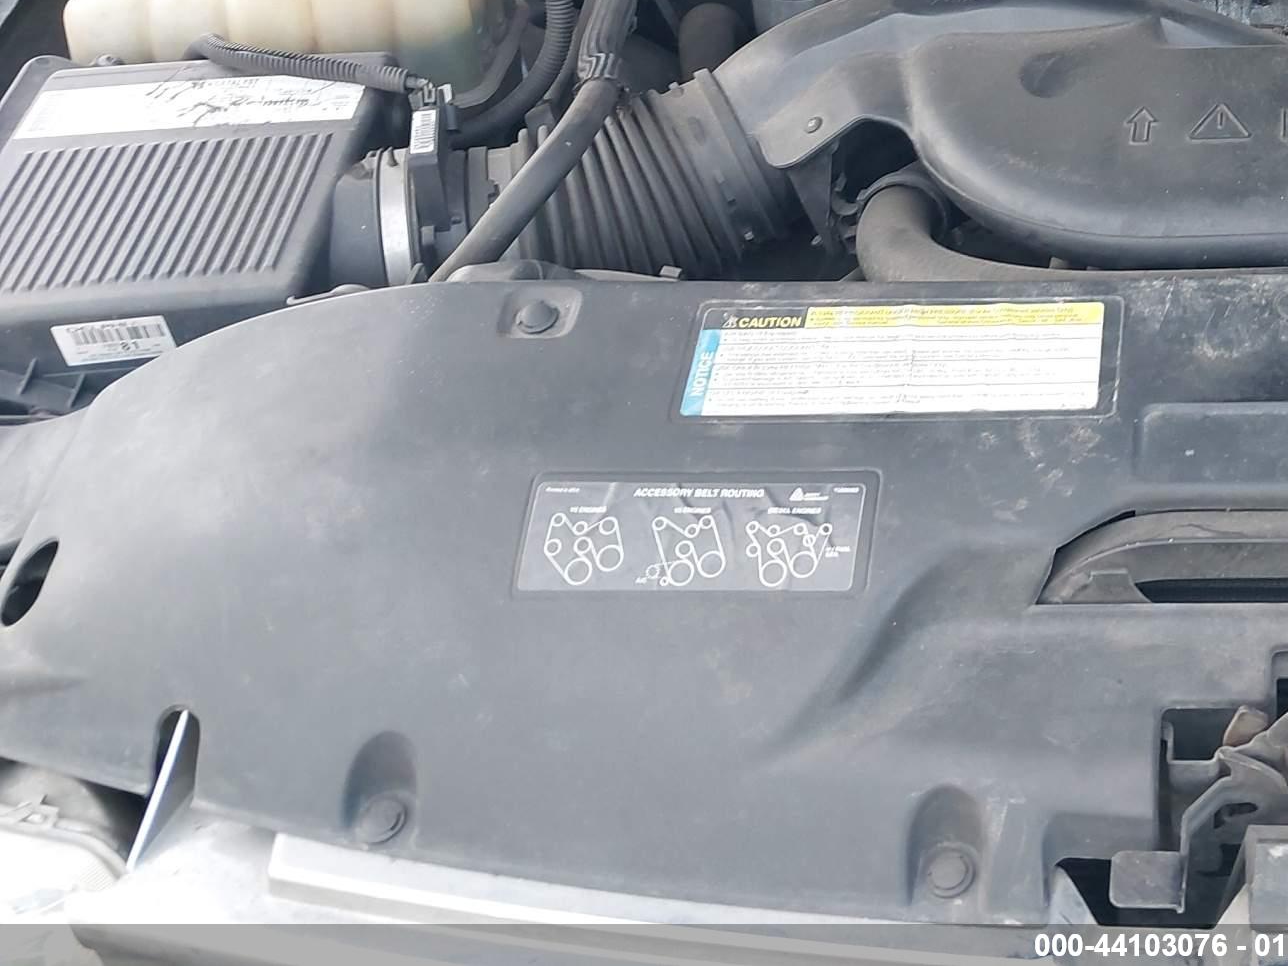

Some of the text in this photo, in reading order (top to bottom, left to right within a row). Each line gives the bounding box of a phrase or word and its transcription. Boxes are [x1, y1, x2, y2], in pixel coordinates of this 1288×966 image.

[738, 316, 802, 329] CAUTION
[688, 350, 714, 399] NOTICE
[633, 487, 765, 498] ACCESSORY BELT ROUTING
